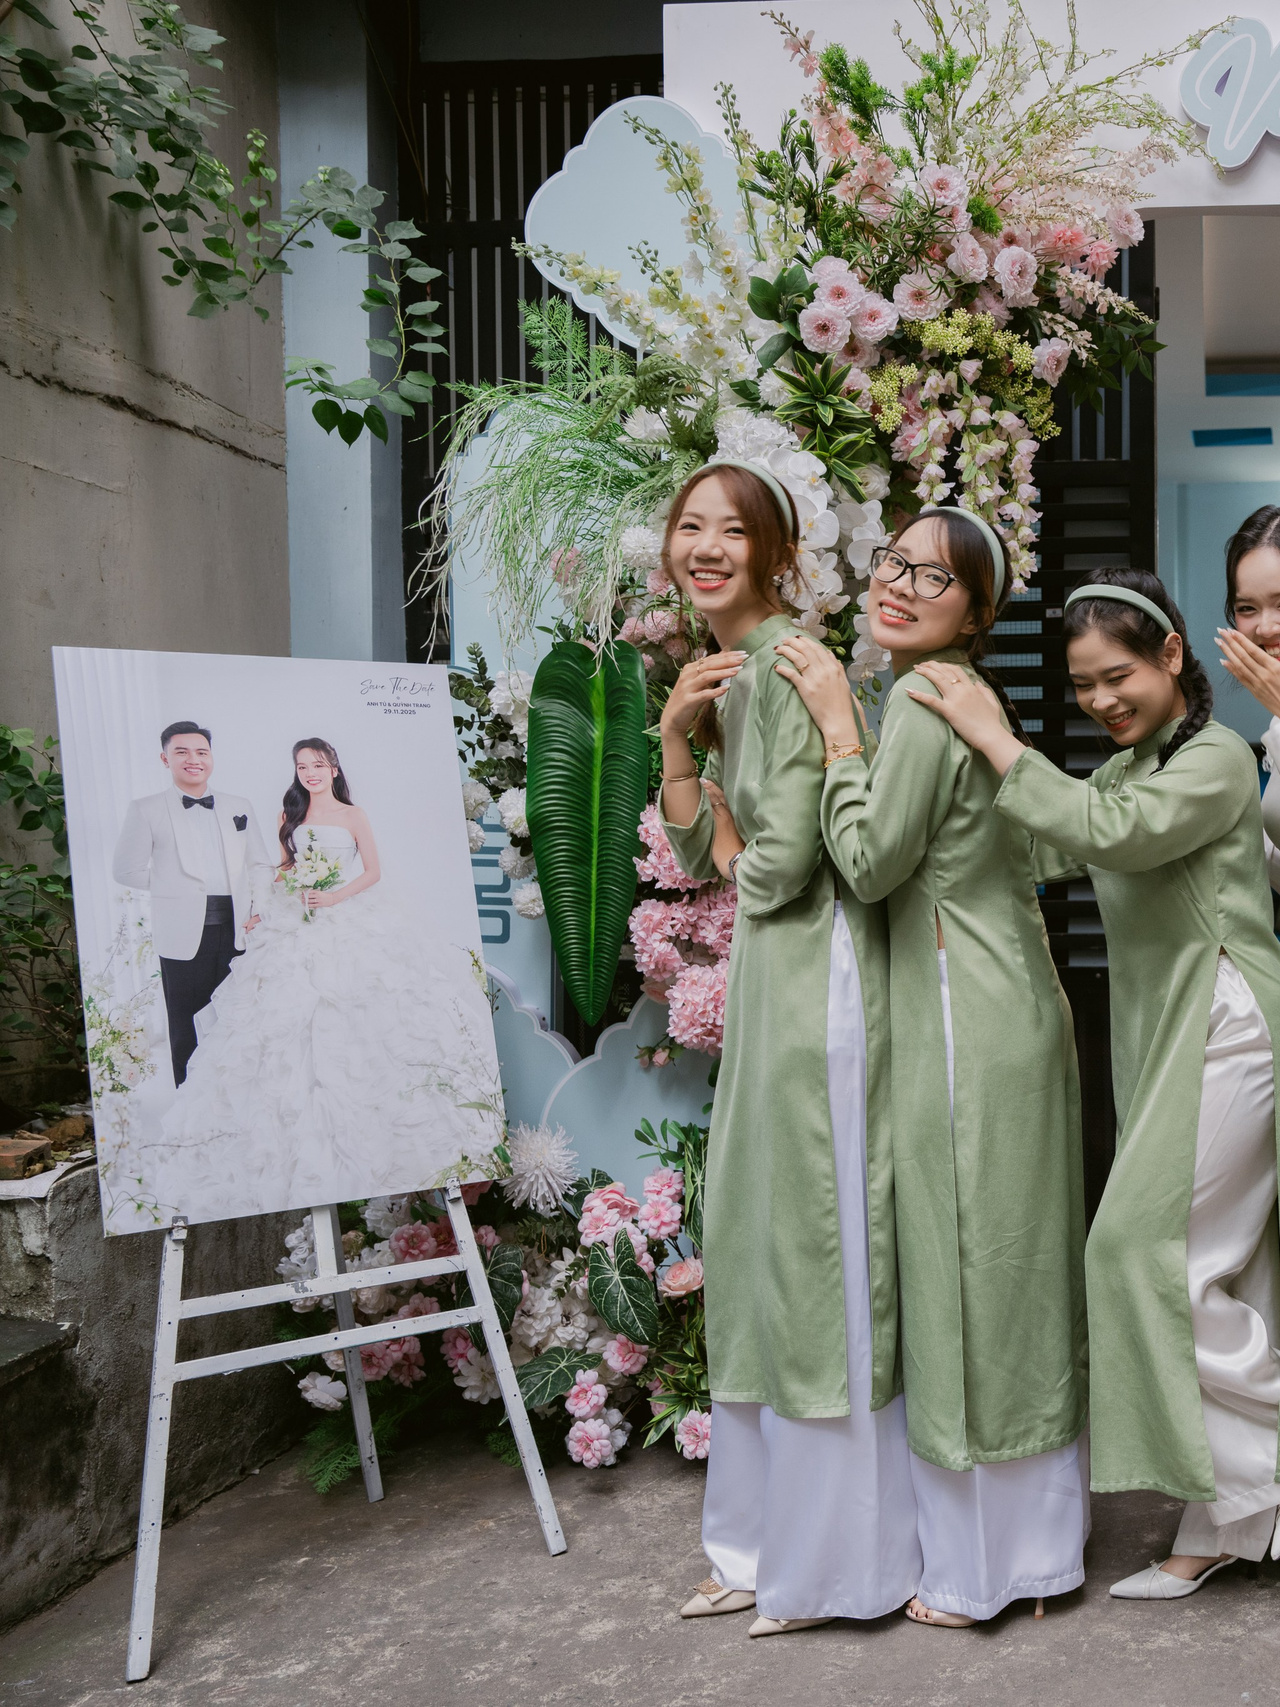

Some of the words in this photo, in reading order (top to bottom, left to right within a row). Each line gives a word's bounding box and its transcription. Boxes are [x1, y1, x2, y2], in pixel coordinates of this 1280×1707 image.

[360, 678, 386, 695] Save
[389, 676, 408, 694] The
[409, 682, 436, 697] Date
